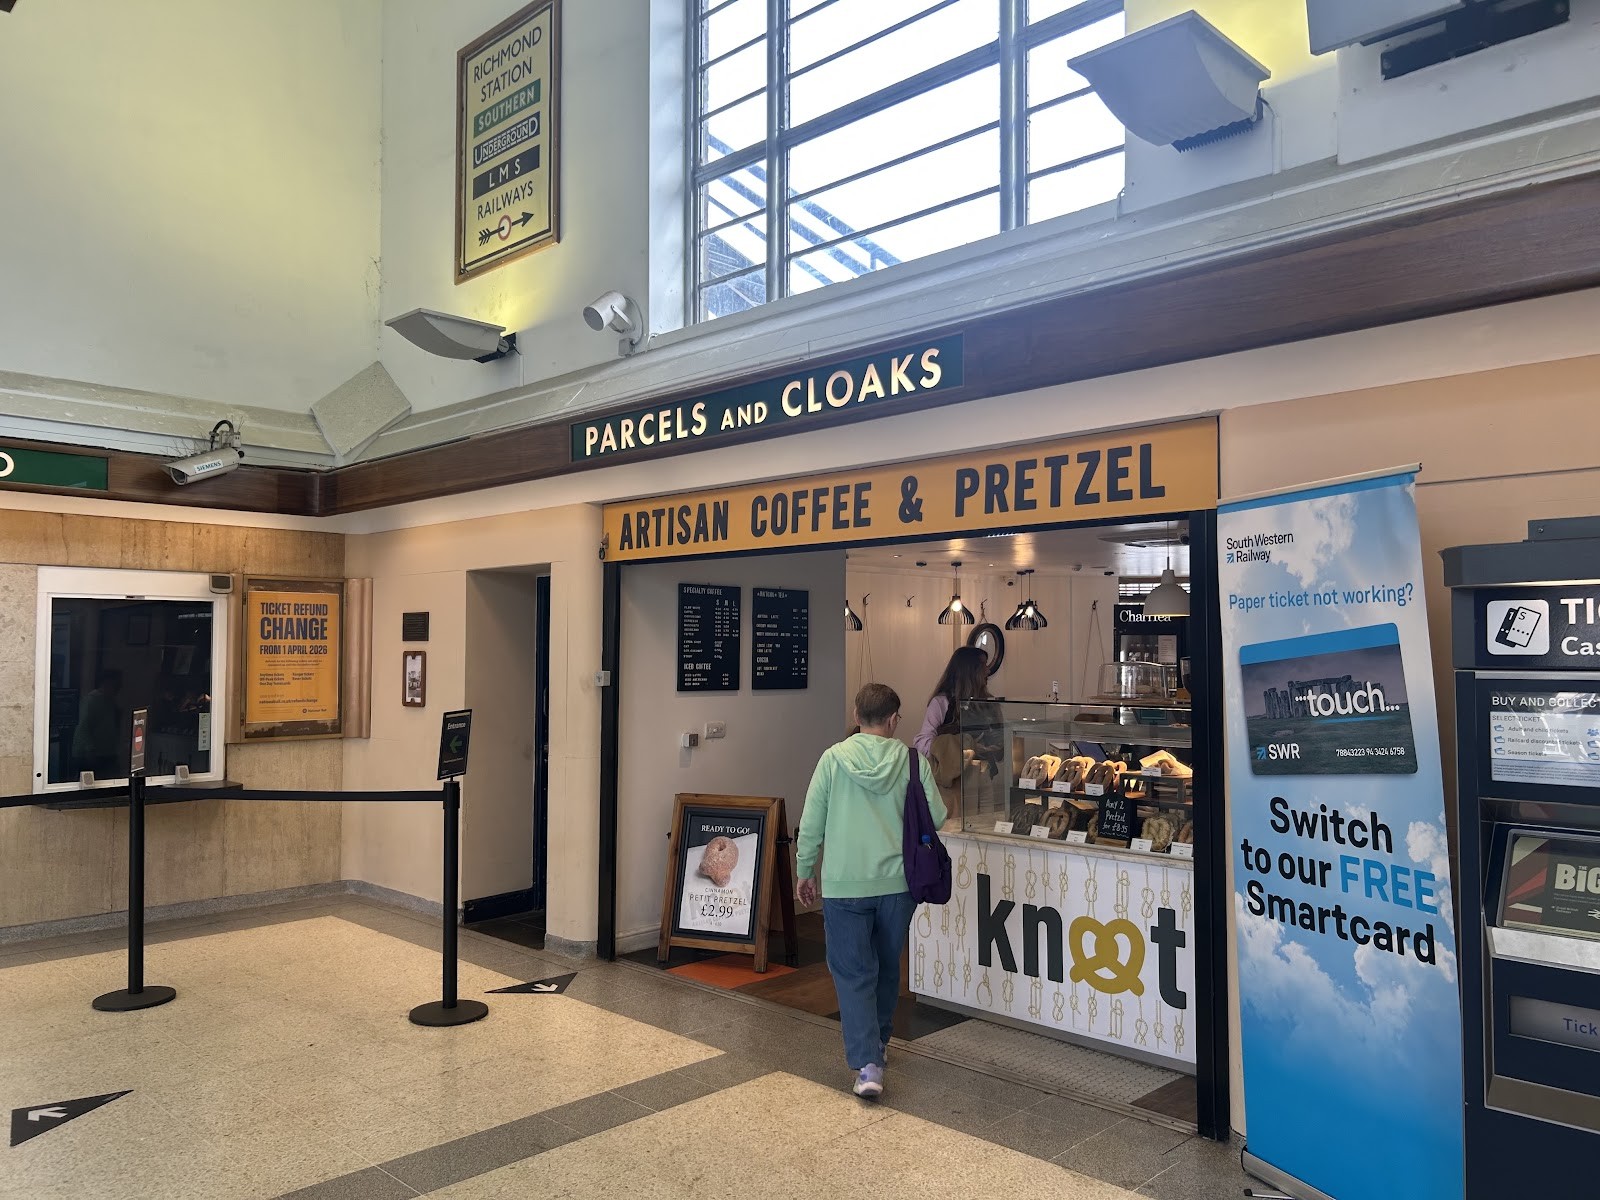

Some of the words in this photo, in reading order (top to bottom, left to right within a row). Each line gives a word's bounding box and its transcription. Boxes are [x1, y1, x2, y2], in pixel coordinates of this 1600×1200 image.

[474, 26, 542, 83] RICHMOND
[481, 56, 532, 102] STATION
[478, 85, 535, 131] SOUTHERN
[474, 117, 538, 165] UNDERGROUND
[477, 180, 533, 220] RAILWAYS
[585, 402, 706, 456] PARCELS
[720, 401, 768, 431] AND
[781, 348, 942, 418] CLOAKS
[197, 462, 221, 471] SIEMENS
[620, 500, 729, 551] ARTISAN
[751, 481, 873, 539] COFFEE
[898, 475, 923, 524] &
[954, 443, 1166, 519] PRETZEL
[1226, 535, 1254, 550] South
[1254, 532, 1294, 545] Western
[1236, 550, 1271, 563] Railway
[1229, 594, 1265, 613] Paper
[1269, 591, 1309, 608] ticket
[1313, 589, 1338, 606] not
[1342, 582, 1414, 607] working?
[260, 602, 291, 615] TICKET
[293, 603, 328, 616] REFUND
[1560, 598, 1600, 625] TI
[260, 616, 328, 640] CHANGE
[260, 645, 281, 655] FROM
[283, 645, 286, 655] 1
[287, 645, 308, 655] APRIL
[309, 645, 328, 655] 2026
[1492, 696, 1516, 706] BUY
[1520, 697, 1545, 707] AND
[447, 722, 466, 730] Entrance
[1268, 743, 1300, 760] SWR
[1389, 746, 1405, 756] 6758
[1119, 801, 1125, 810] 2
[701, 824, 725, 833] READY
[726, 826, 736, 834] TO
[736, 826, 750, 835] GO!
[1102, 822, 1111, 830] for
[1270, 796, 1393, 854] Switch
[1240, 838, 1272, 874] to
[1278, 852, 1332, 888] our
[1339, 854, 1438, 915] FREE
[689, 893, 711, 902] PETIT
[713, 896, 747, 906] PRETZEL
[700, 904, 733, 919] £2.99
[1247, 880, 1436, 965] Smartcard
[1562, 1017, 1598, 1036] Tick
